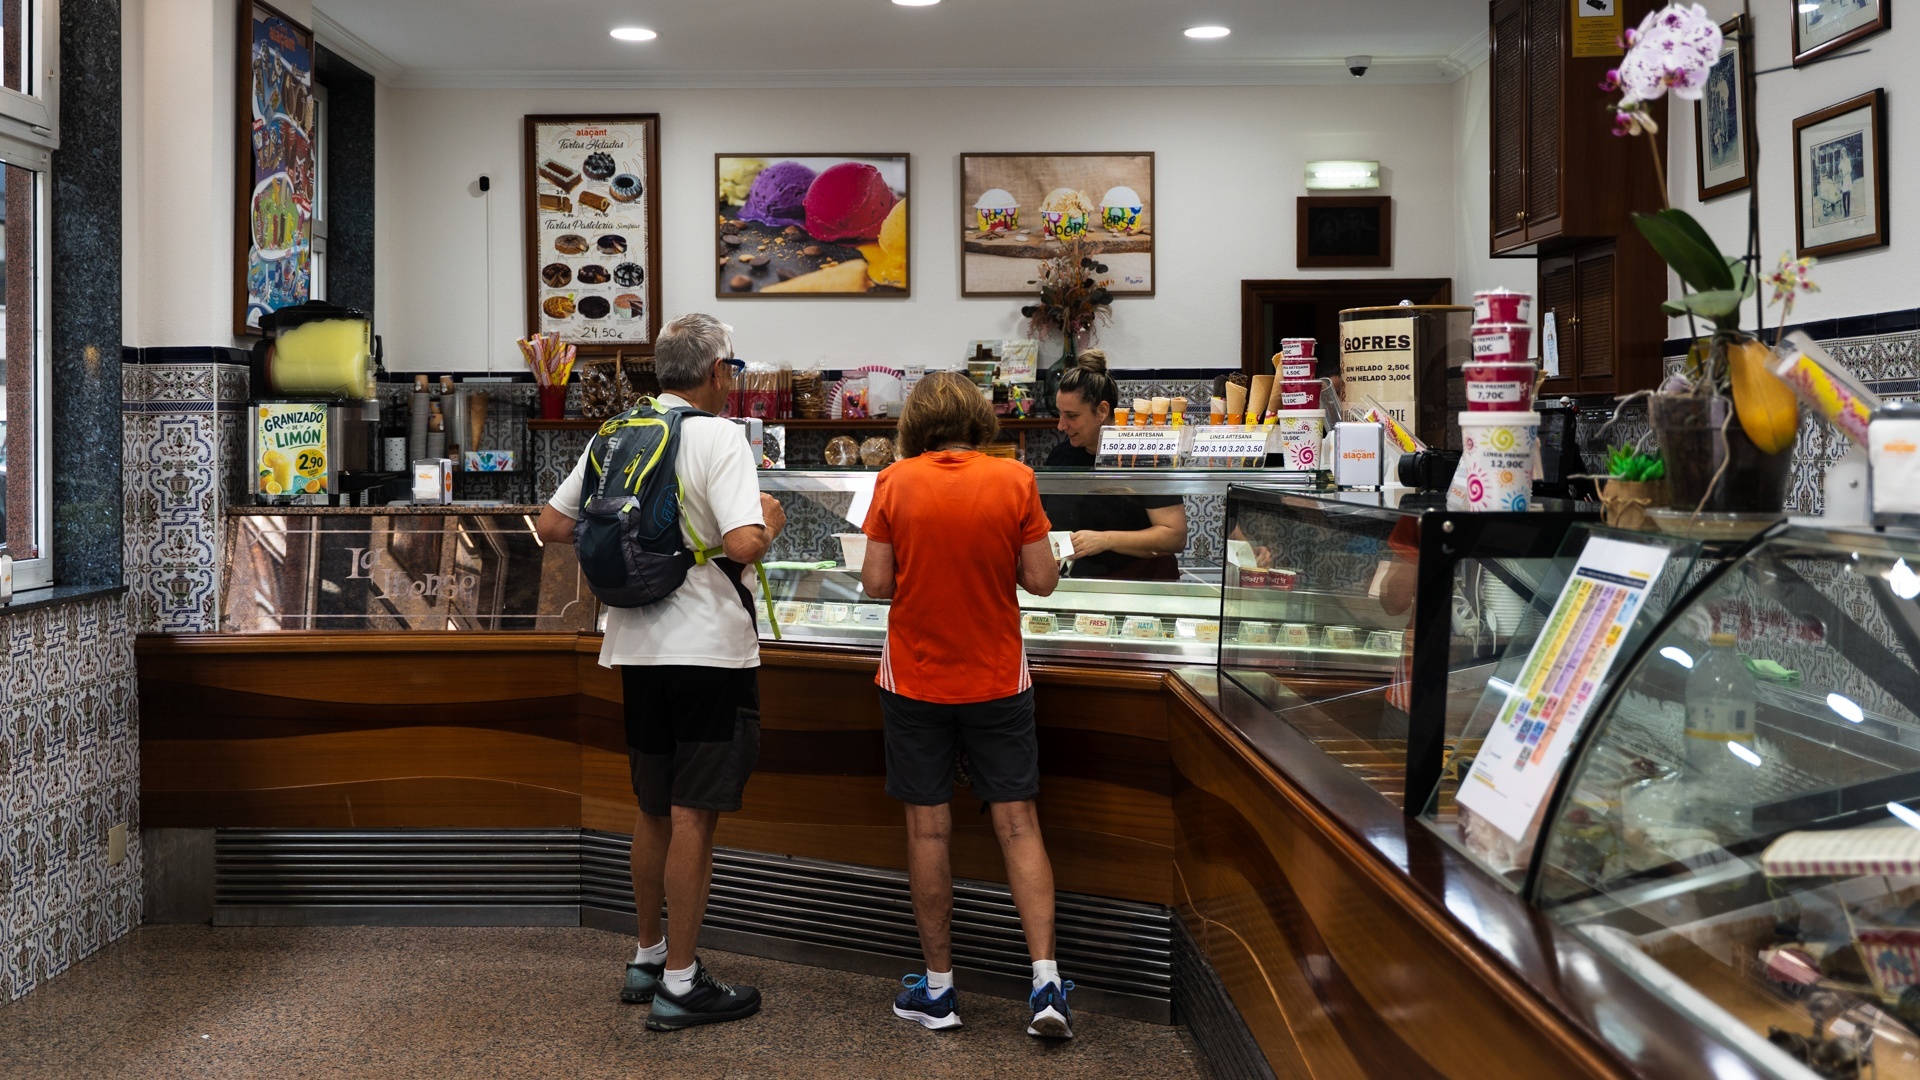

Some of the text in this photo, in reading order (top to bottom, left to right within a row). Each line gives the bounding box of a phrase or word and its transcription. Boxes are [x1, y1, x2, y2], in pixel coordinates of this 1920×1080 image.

[576, 129, 607, 139] alaçant
[558, 138, 624, 150] Tartas Heladas
[545, 220, 572, 230] Tartas
[1344, 334, 1411, 350] GOFRES
[1477, 392, 1504, 400] 7,70€
[264, 412, 324, 432] GRANIZADO
[276, 426, 322, 448] LIMÓN
[298, 454, 324, 470] 2.90
[1343, 452, 1376, 462] alaçant
[597, 436, 619, 500] mountain
[1491, 460, 1524, 468] 12,90€
[1197, 624, 1218, 632] LIMÓN
